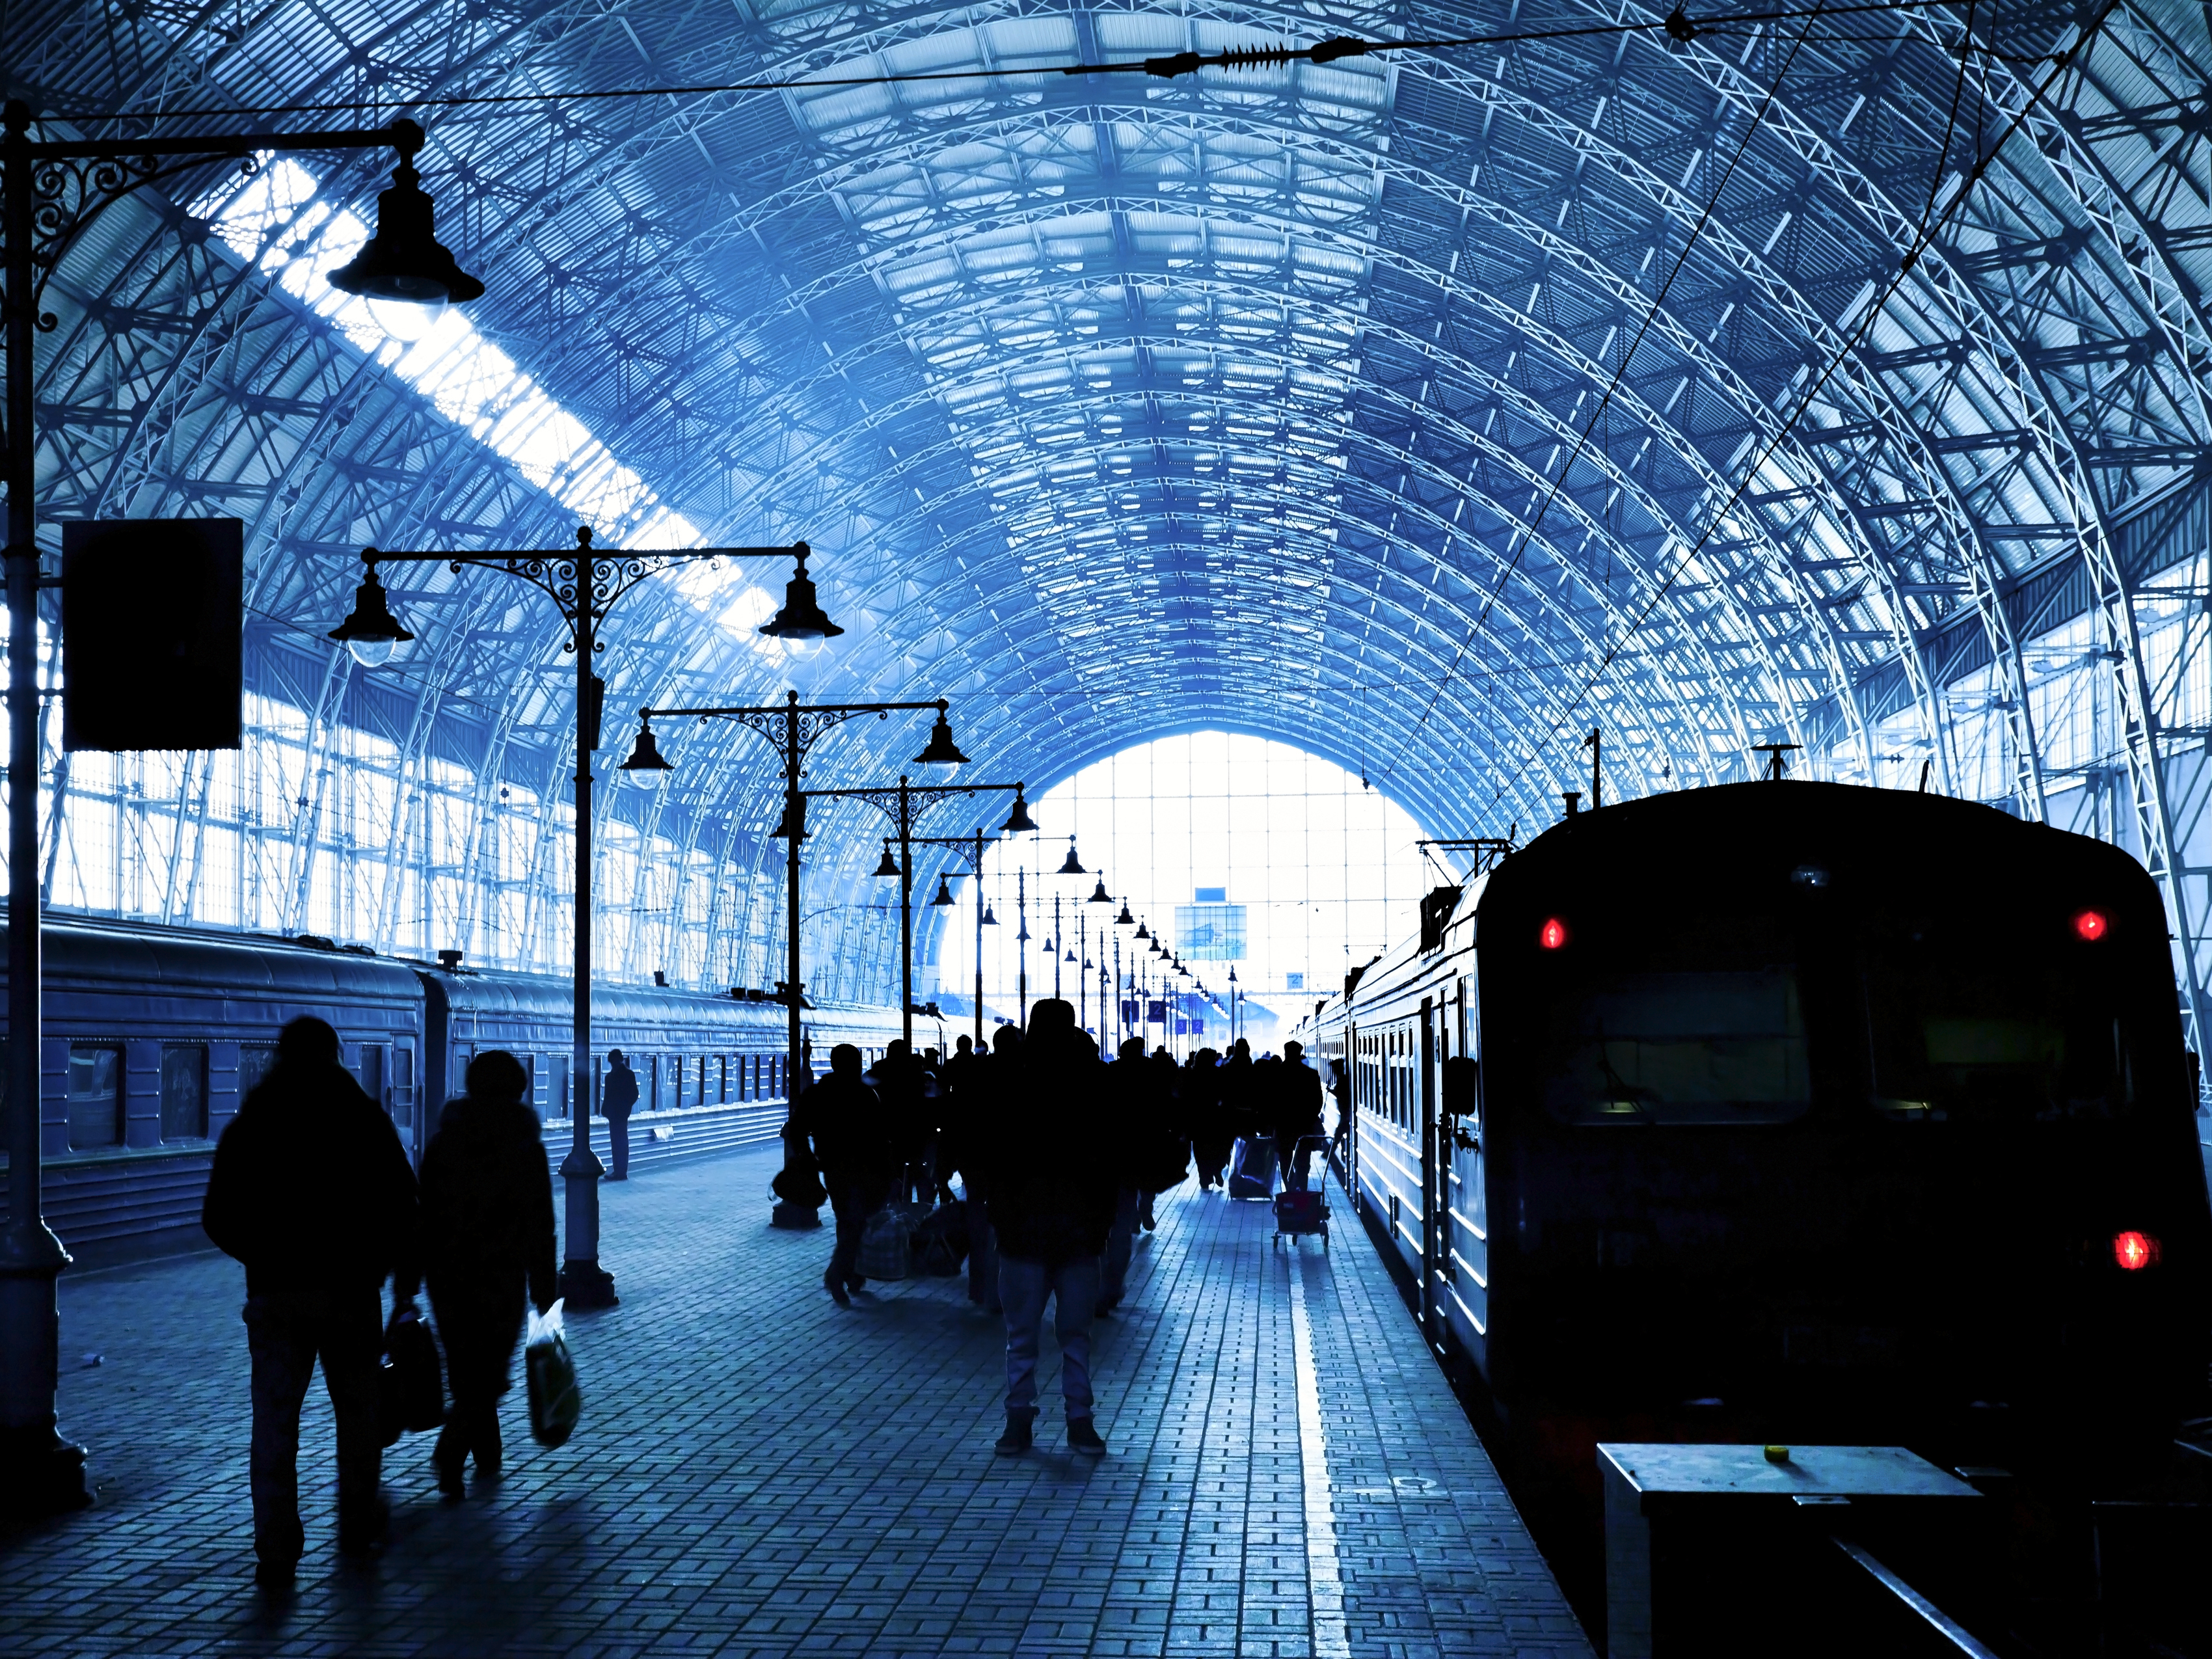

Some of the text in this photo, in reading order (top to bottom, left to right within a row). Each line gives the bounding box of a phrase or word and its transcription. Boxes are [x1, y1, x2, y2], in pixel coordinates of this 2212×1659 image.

[1292, 975, 1299, 984] 2
[1153, 1004, 1161, 1015] 2
[1195, 1021, 1200, 1029] 2
